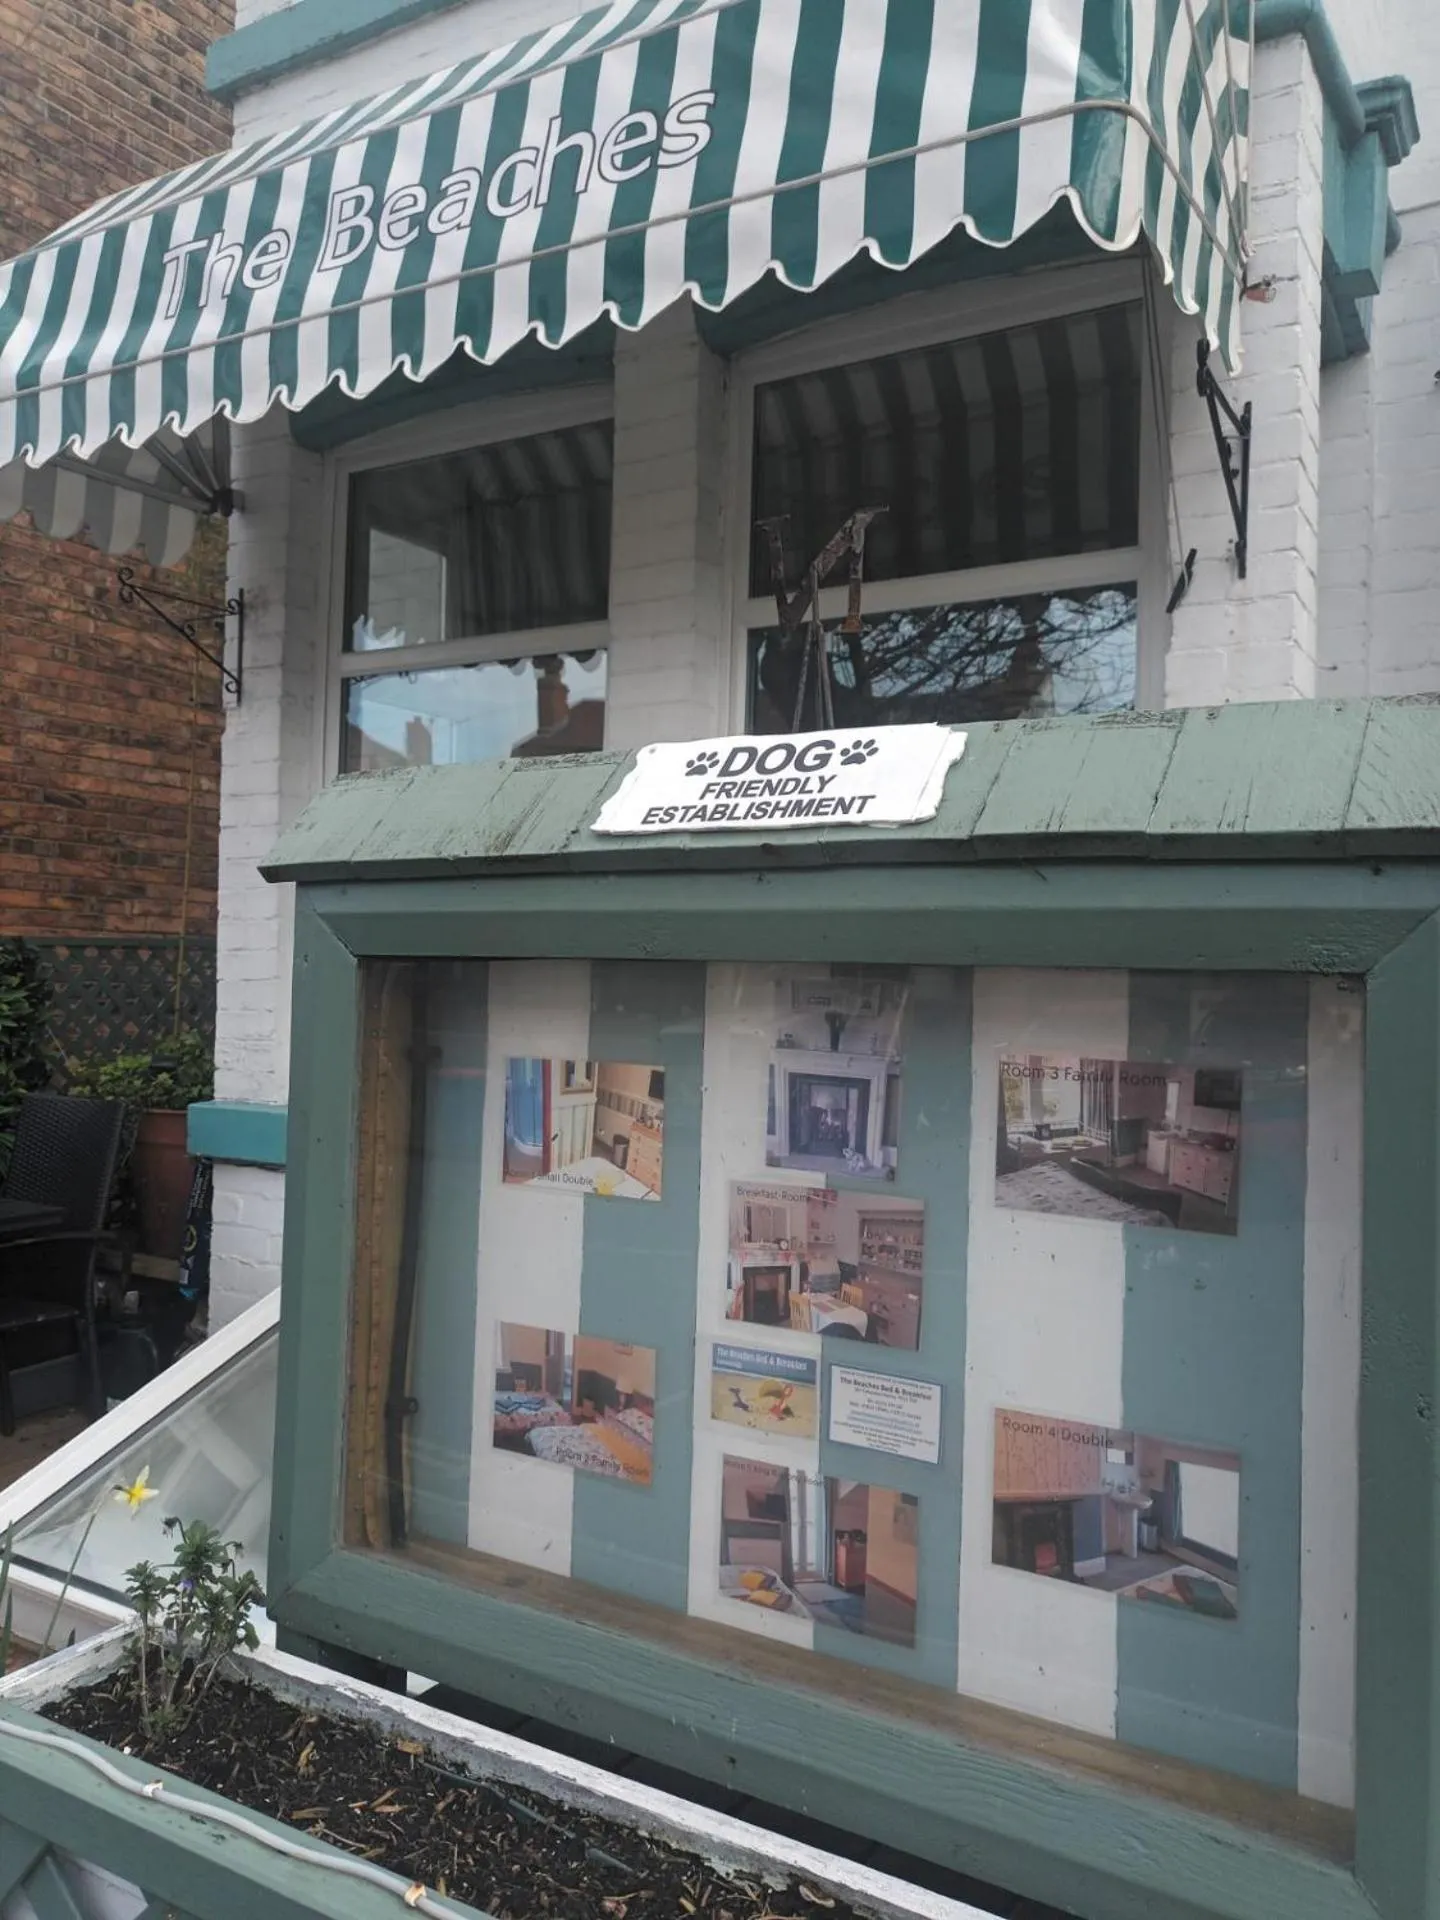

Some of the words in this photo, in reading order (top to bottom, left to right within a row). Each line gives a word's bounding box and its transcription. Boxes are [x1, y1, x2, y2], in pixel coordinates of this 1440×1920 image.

[162, 227, 290, 320] The
[317, 89, 716, 273] Beaches
[717, 739, 836, 777] DOG
[698, 774, 838, 800] FRIENDLY
[641, 795, 877, 825] ESTABLISHMENT
[1000, 1062, 1046, 1080] Room
[1049, 1067, 1059, 1081] 3
[1063, 1067, 1114, 1086] Family
[1118, 1070, 1167, 1087] Room
[562, 1173, 594, 1187] Double
[840, 1376, 852, 1385] The
[853, 1379, 879, 1391] Beaches
[1001, 1416, 1044, 1435] Room
[1048, 1427, 1057, 1438] 4
[1061, 1427, 1114, 1449] Double
